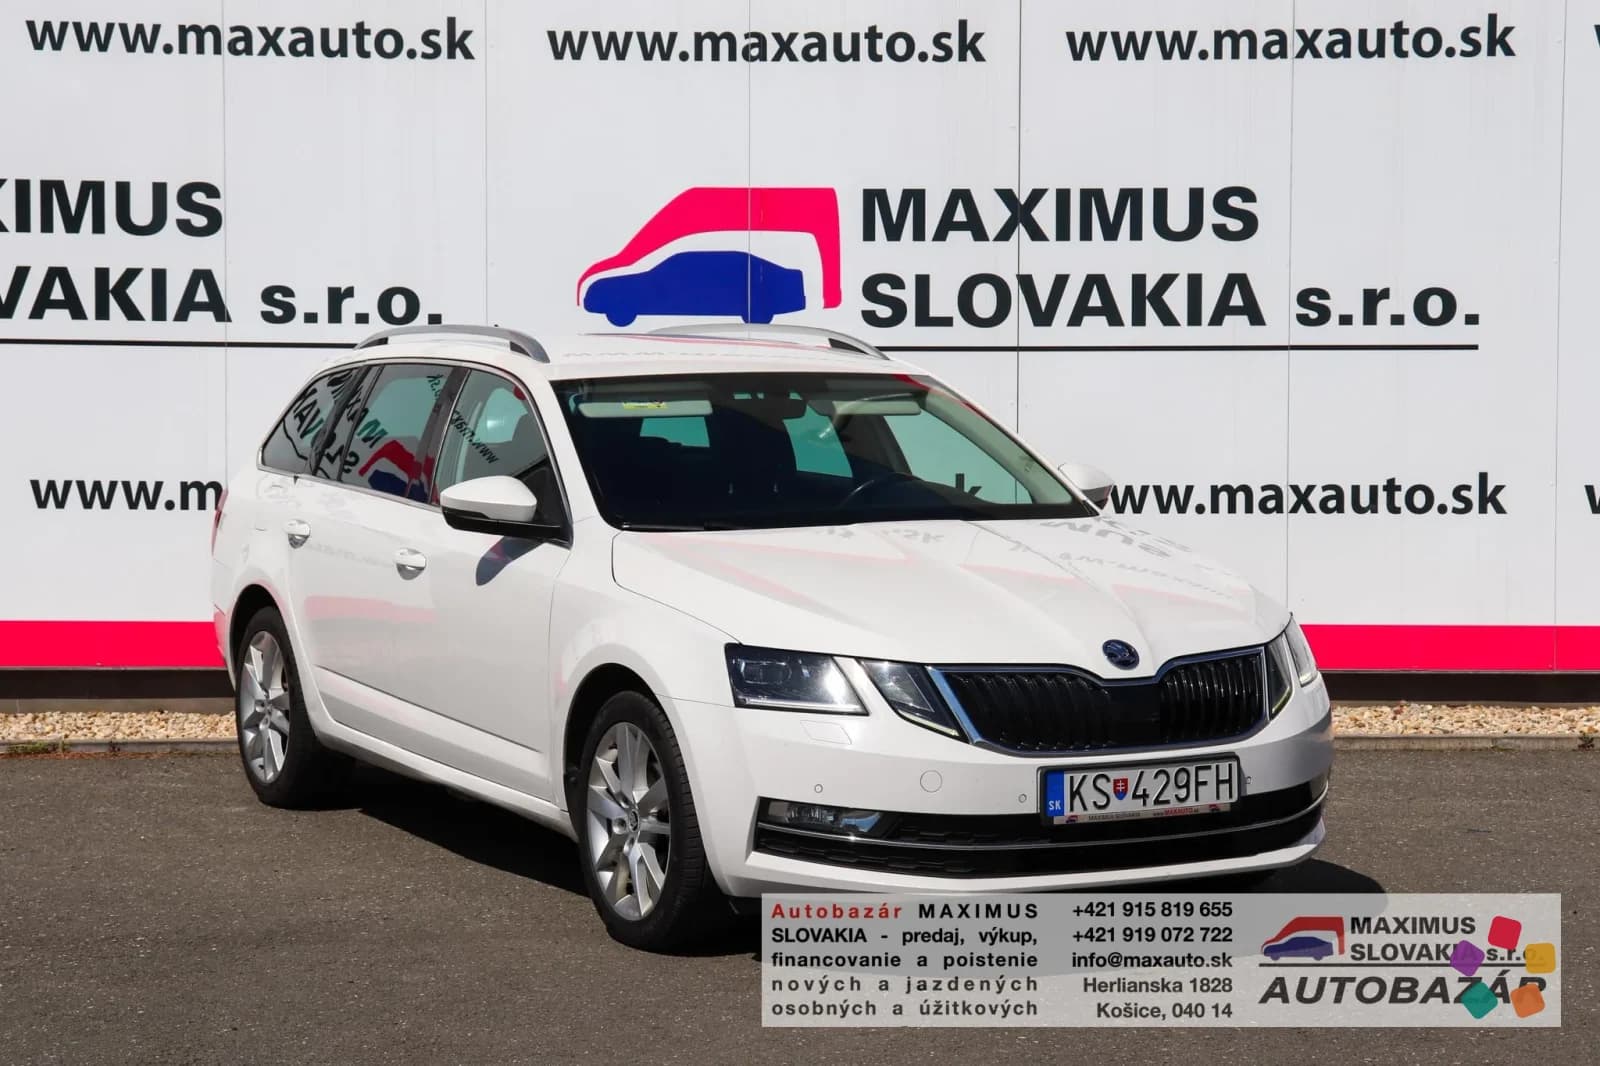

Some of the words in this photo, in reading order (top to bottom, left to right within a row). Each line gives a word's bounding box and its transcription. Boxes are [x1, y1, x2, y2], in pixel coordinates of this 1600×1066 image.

[26, 17, 474, 60] www.maxauto.sk
[548, 20, 985, 62] www.maxauto.sk
[1066, 14, 1515, 60] www.maxauto.sk
[0, 179, 222, 237] IMUS
[863, 187, 1258, 242] MAXIMUS
[261, 286, 442, 325] s.r.o.
[862, 274, 1265, 327] SLOVAKIA
[1296, 288, 1479, 326] s.r.o.
[1048, 801, 1061, 811] SK
[1069, 774, 1111, 811] KS
[1132, 763, 1233, 807] 429FH
